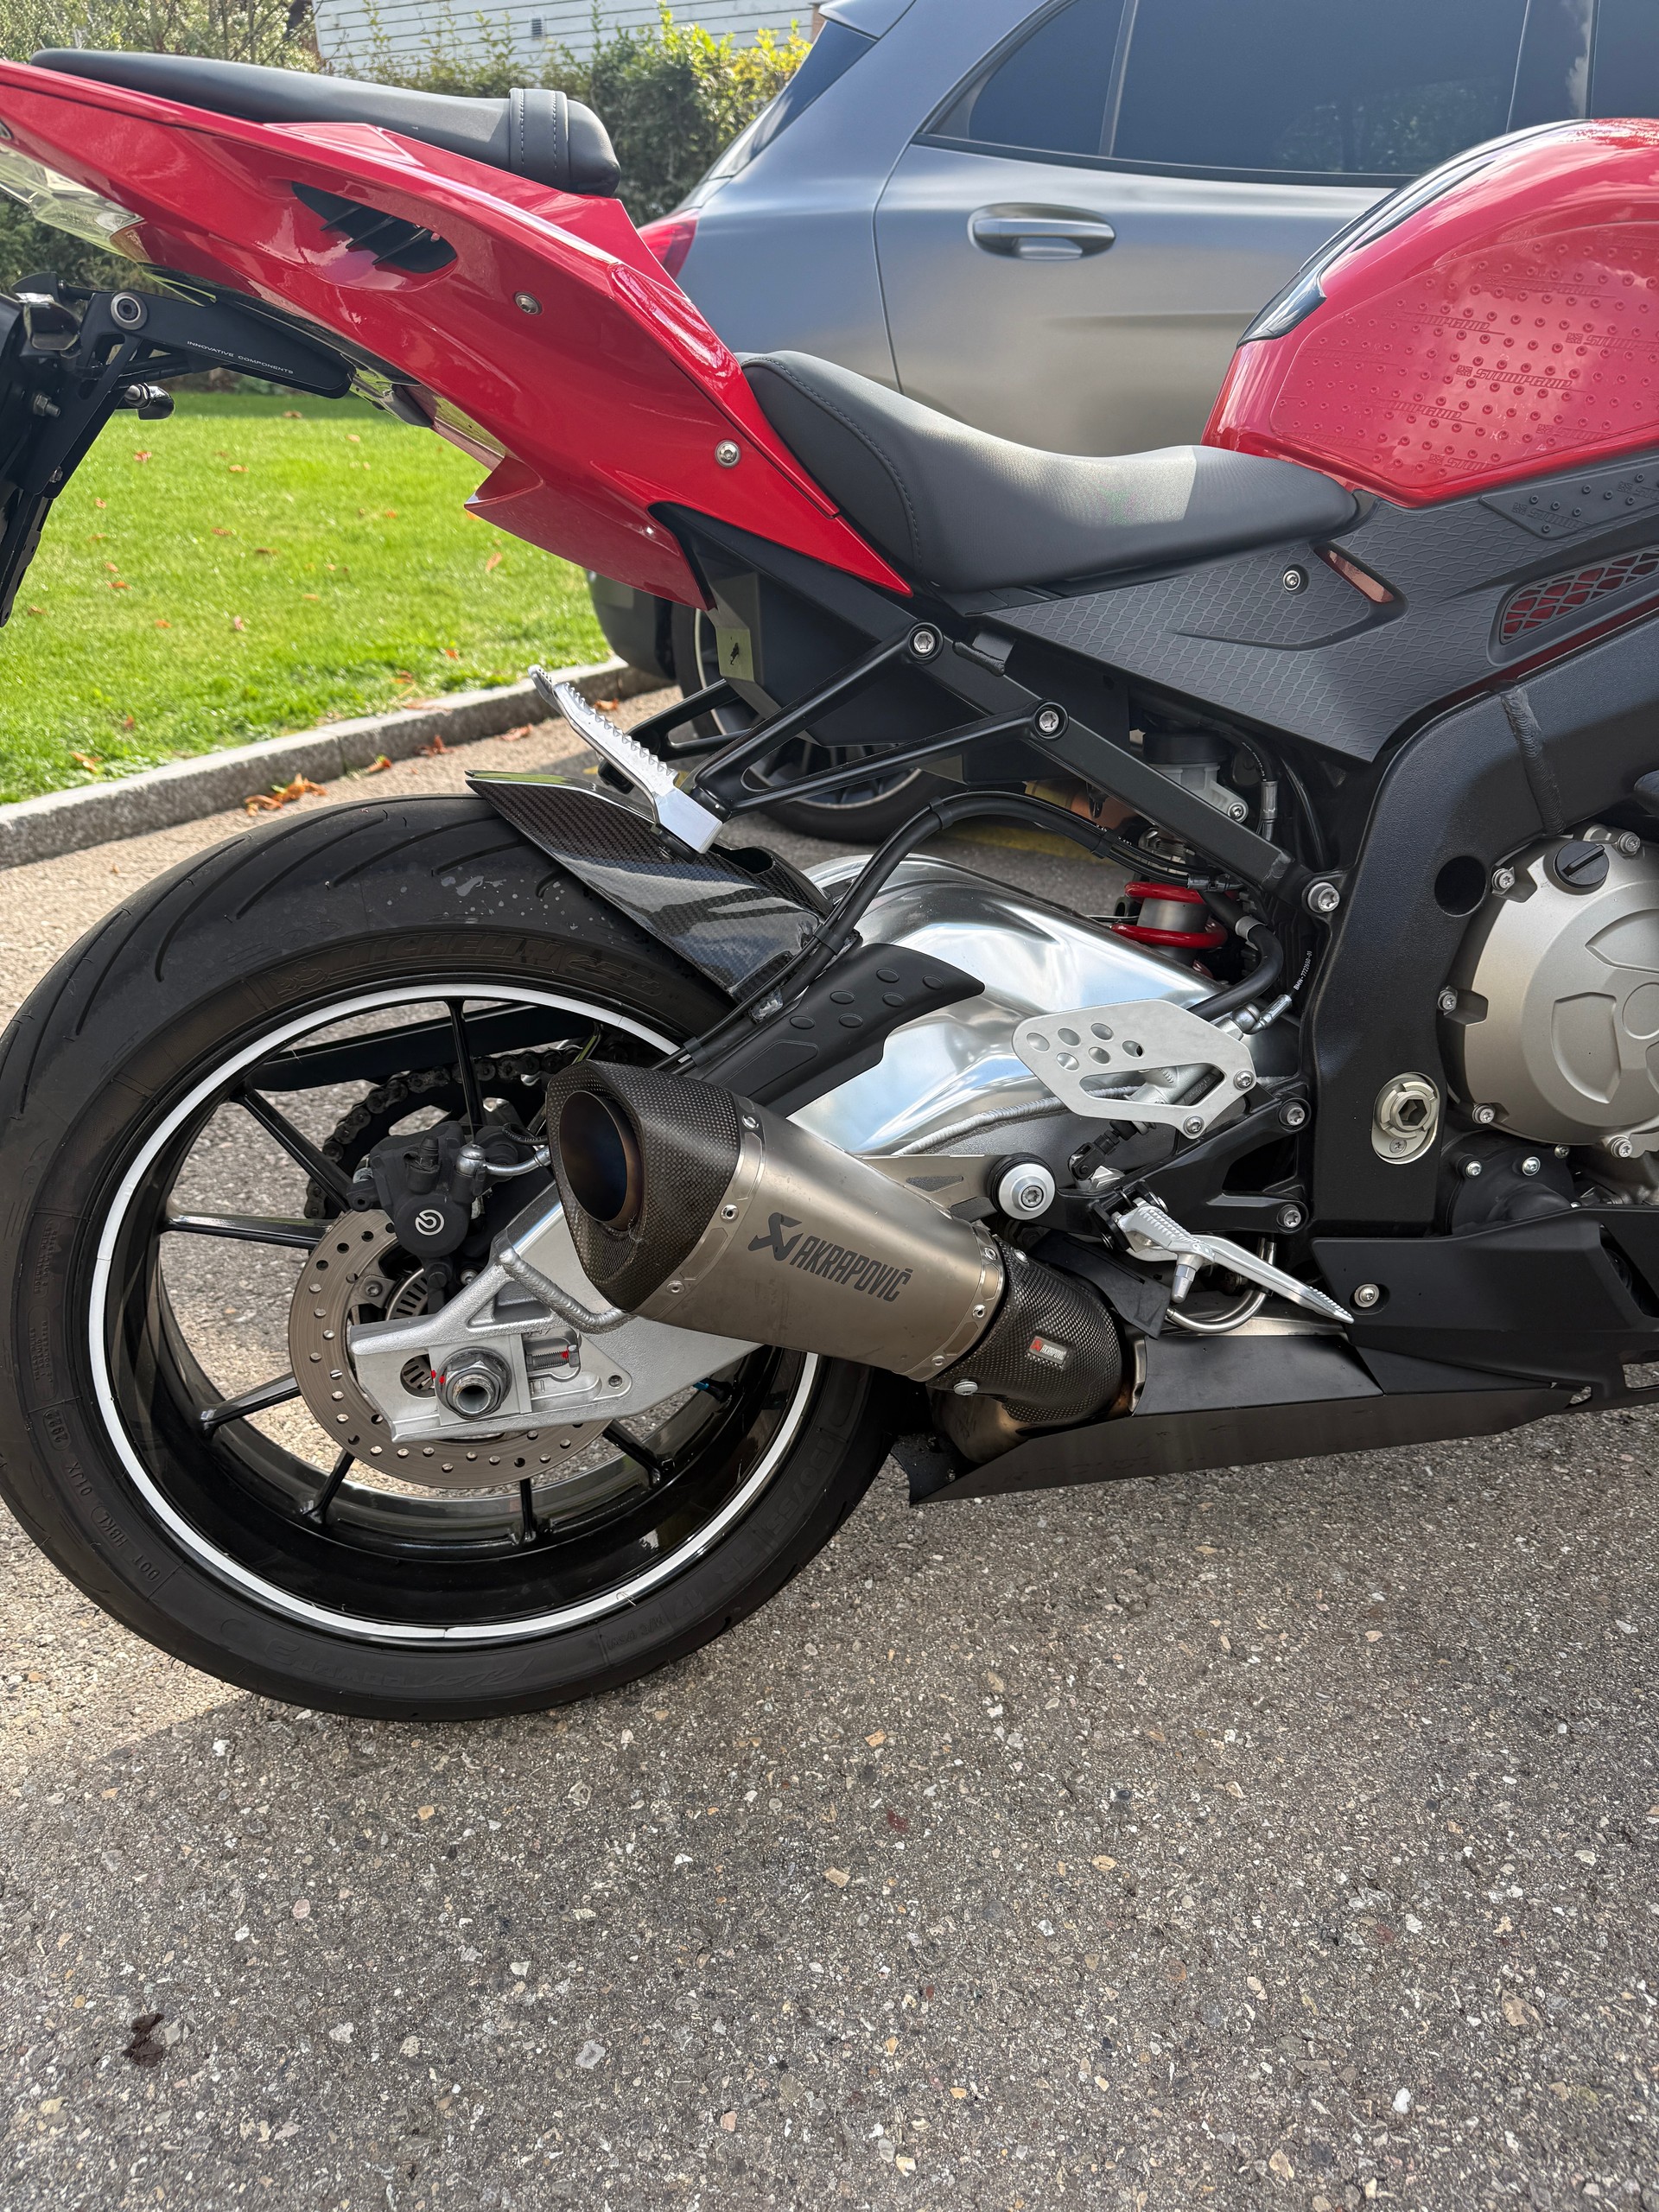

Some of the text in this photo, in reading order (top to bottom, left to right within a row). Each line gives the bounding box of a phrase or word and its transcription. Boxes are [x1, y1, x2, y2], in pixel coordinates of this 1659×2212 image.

[187, 340, 294, 374] INNOVATIVE COMPONENTS
[1473, 368, 1573, 390] STOMPGRIP
[329, 932, 565, 969] MICHELIN
[65, 1461, 92, 1497] 01JX
[98, 1512, 129, 1548] HBKL
[131, 1554, 161, 1582] DOT
